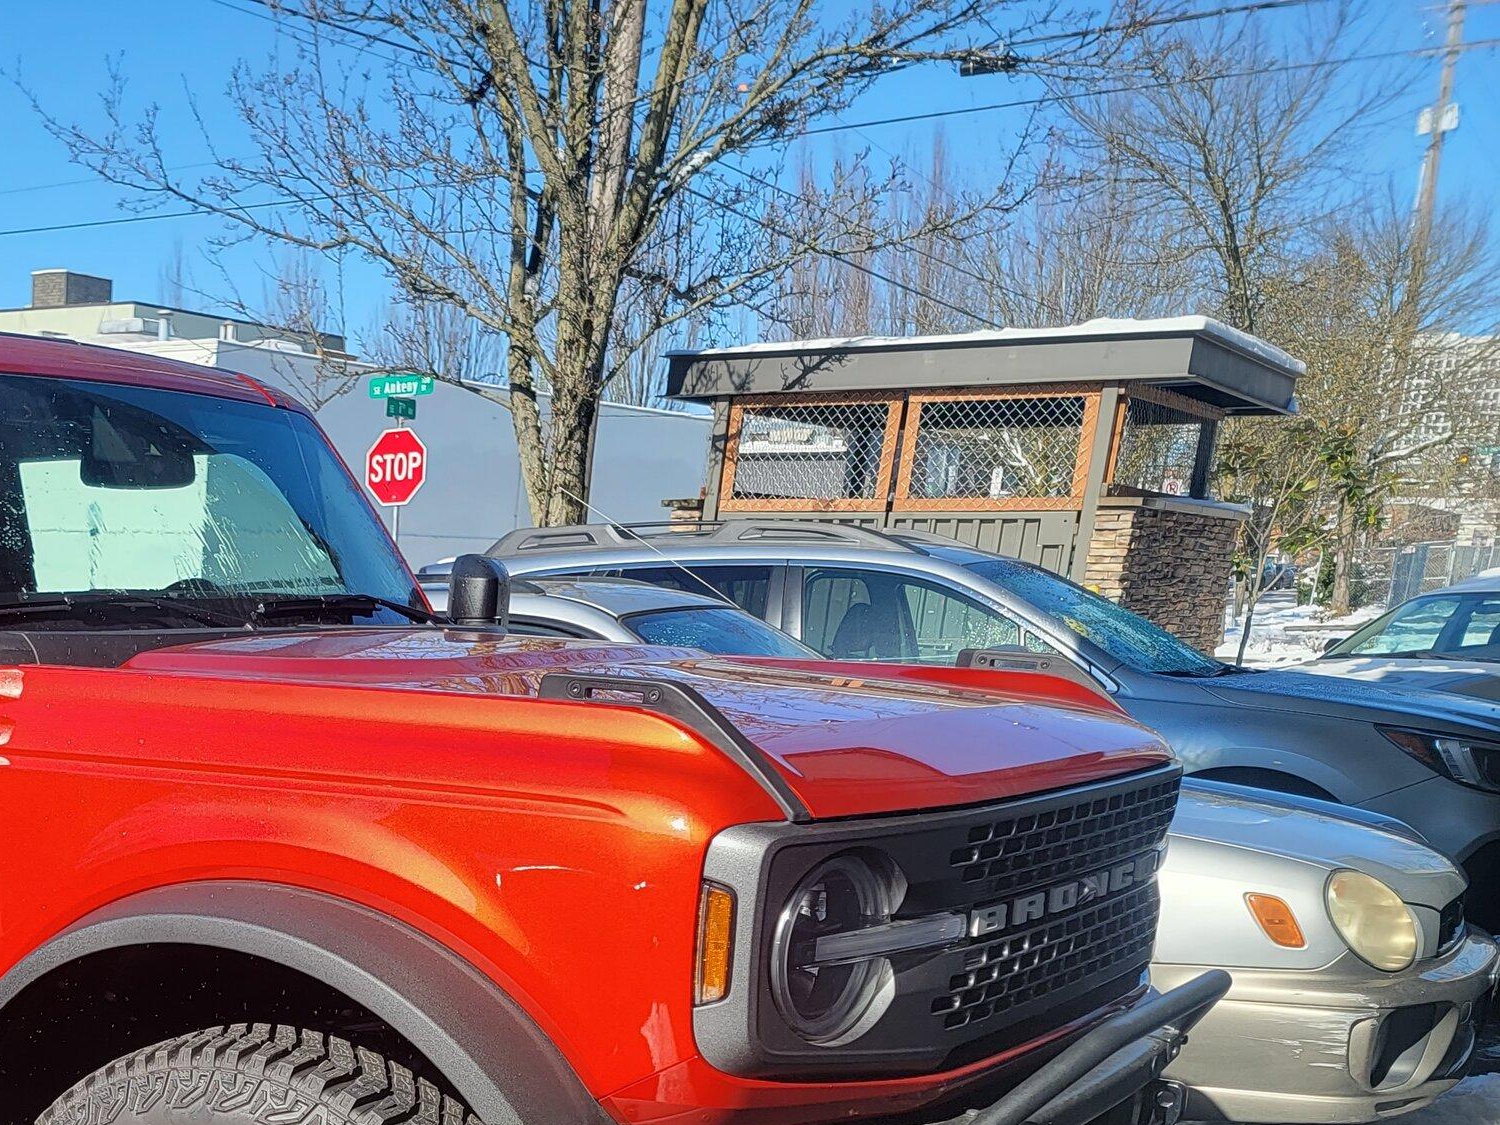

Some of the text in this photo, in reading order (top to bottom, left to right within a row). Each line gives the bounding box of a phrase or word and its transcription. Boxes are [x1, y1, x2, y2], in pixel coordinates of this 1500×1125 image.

[383, 380, 419, 396] Ankeny
[370, 451, 421, 484] STOP
[969, 851, 1159, 938] BRONCO
